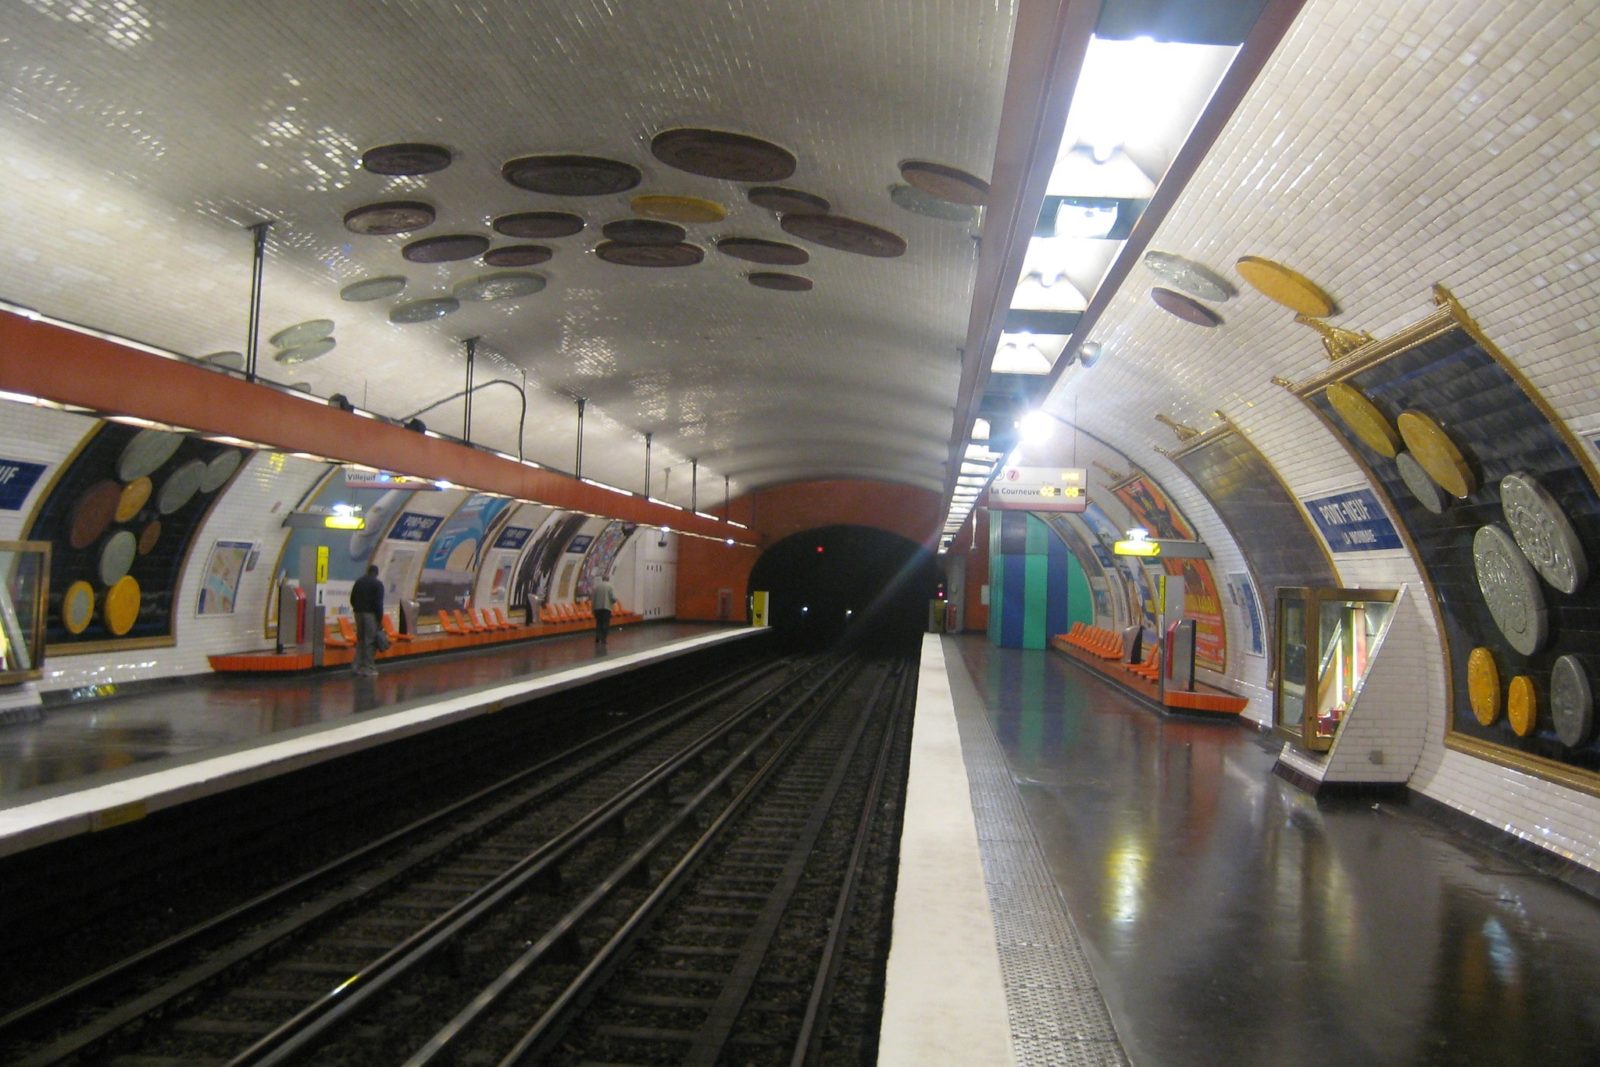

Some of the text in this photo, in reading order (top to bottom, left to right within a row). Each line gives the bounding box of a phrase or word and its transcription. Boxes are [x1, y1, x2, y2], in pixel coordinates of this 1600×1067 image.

[347, 474, 376, 482] Villejuif
[990, 487, 1040, 495] La Courneuve
[1318, 499, 1371, 526] PONT-NEUF
